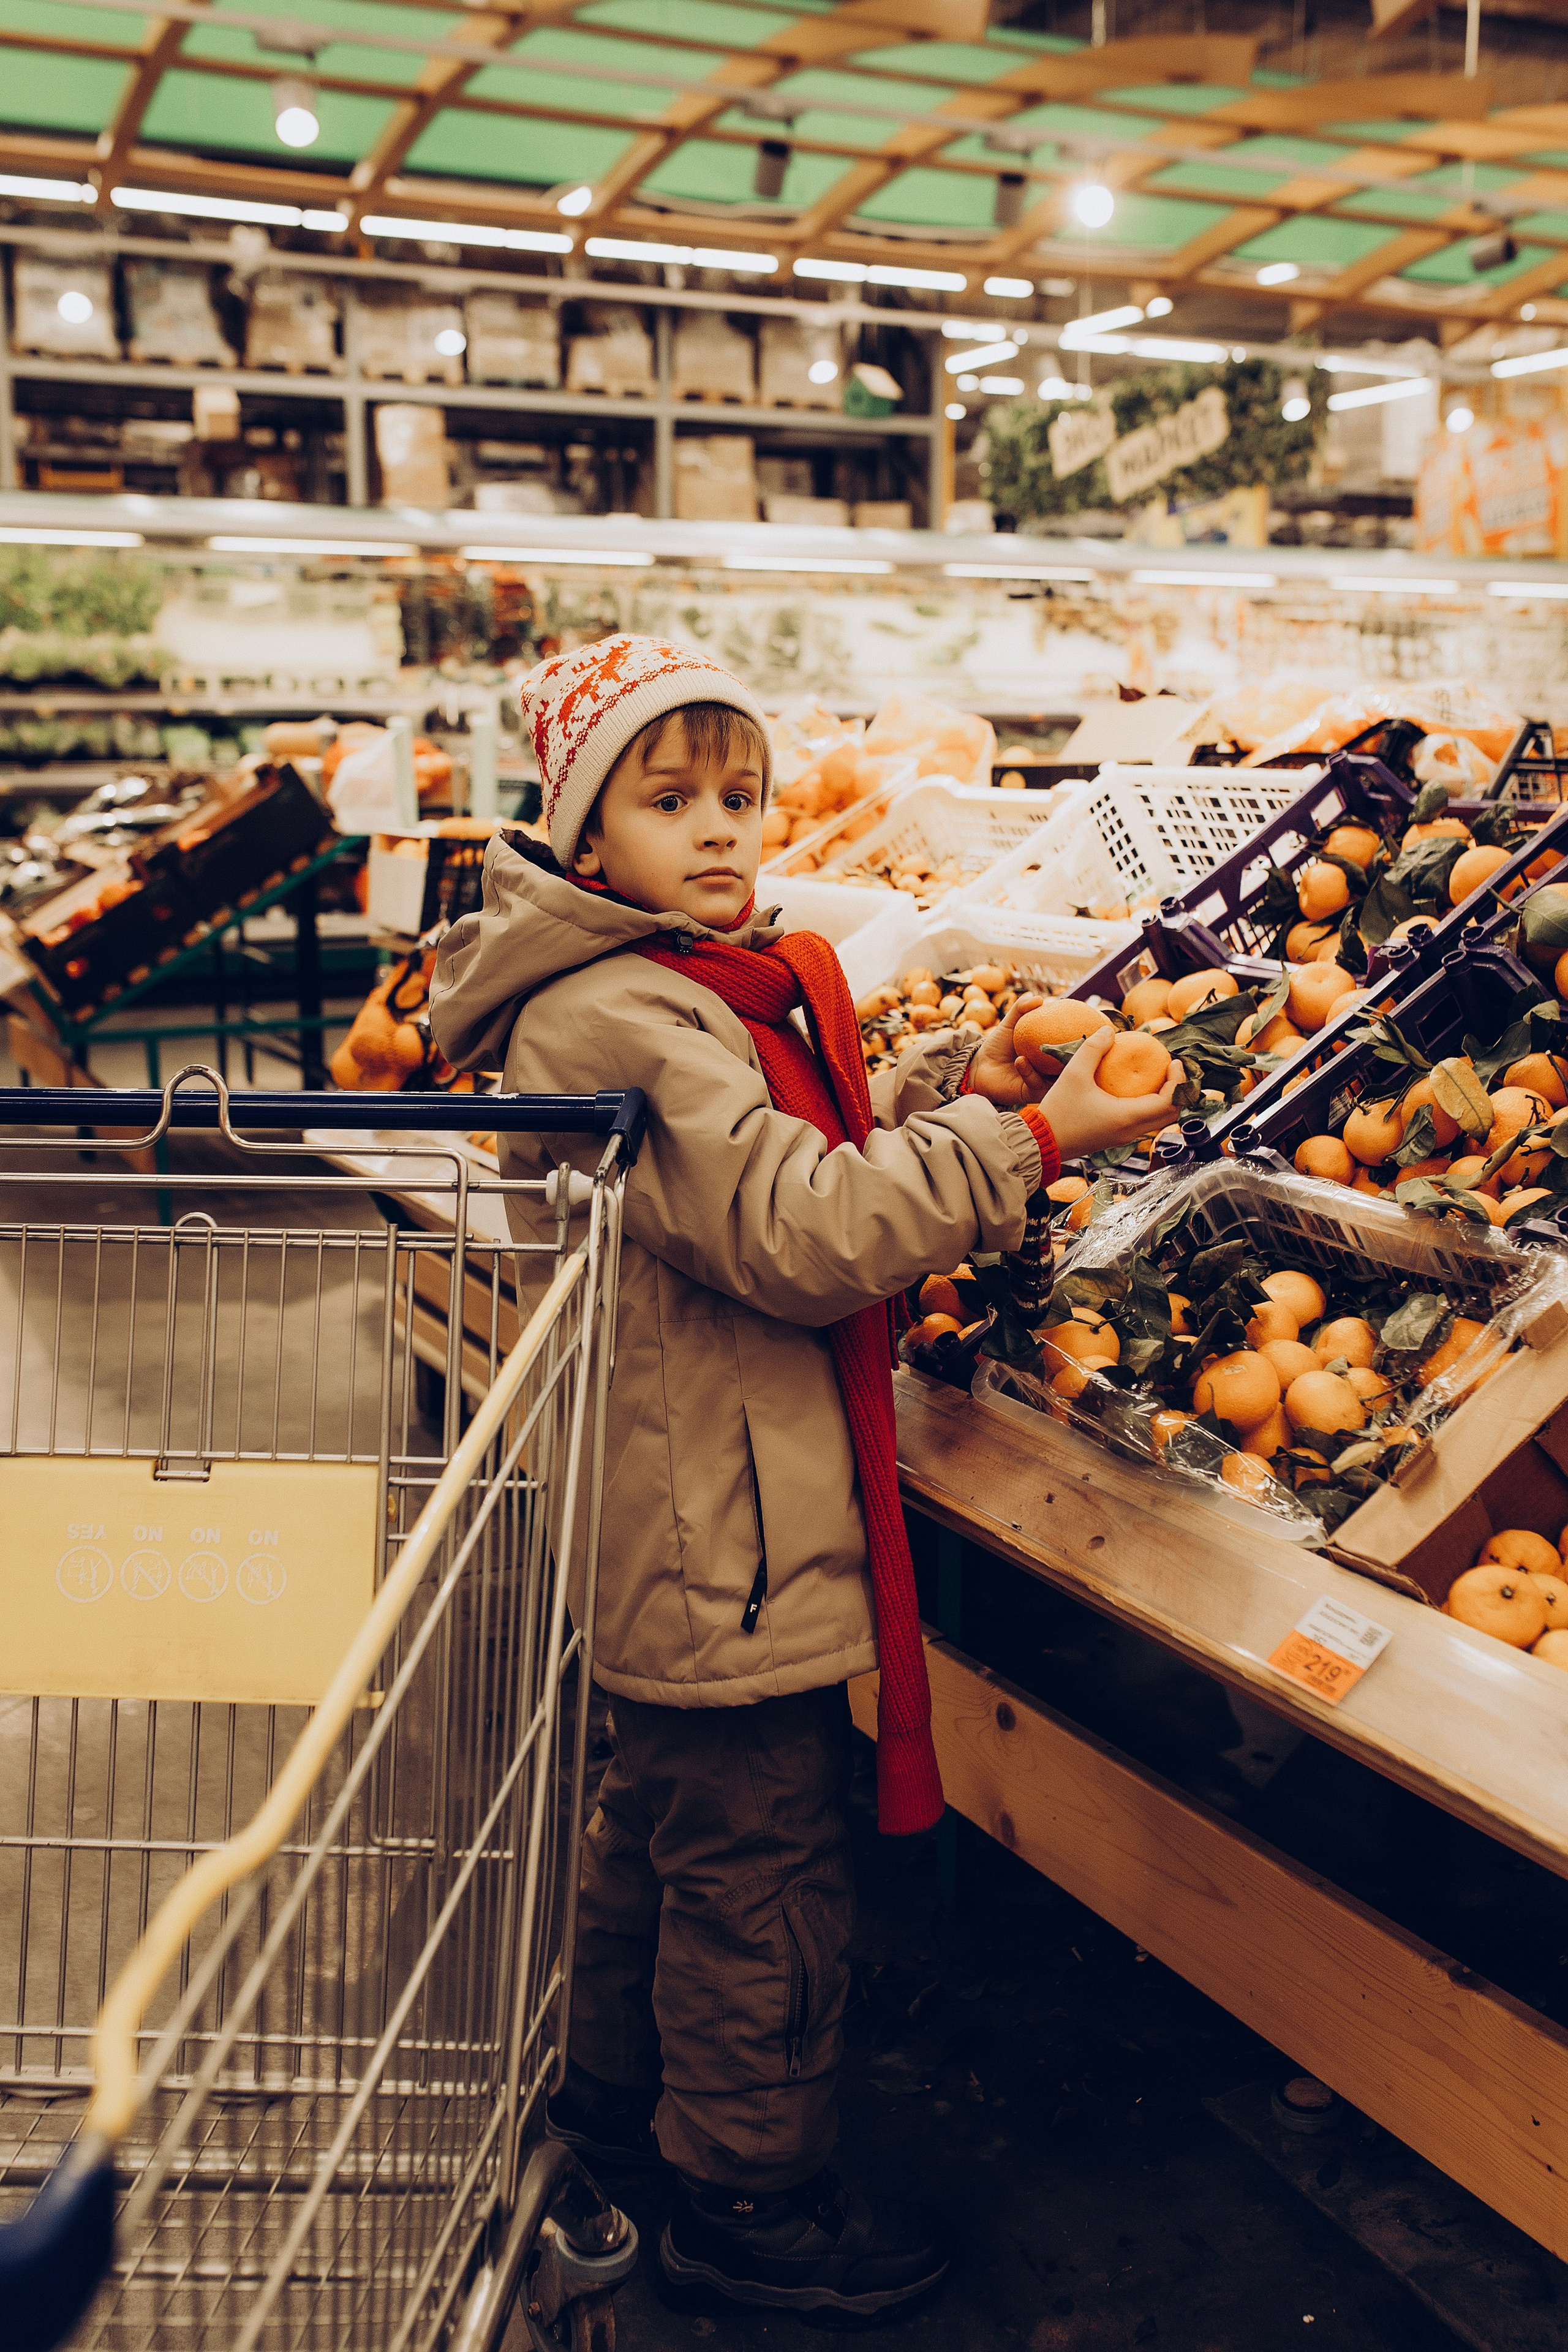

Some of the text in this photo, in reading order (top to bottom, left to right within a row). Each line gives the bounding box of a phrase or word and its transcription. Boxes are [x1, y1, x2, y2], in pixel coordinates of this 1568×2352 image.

[66, 1523, 279, 1545] NO NO NO YES
[750, 1604, 758, 1613] F
[1303, 1654, 1342, 1682] 219
